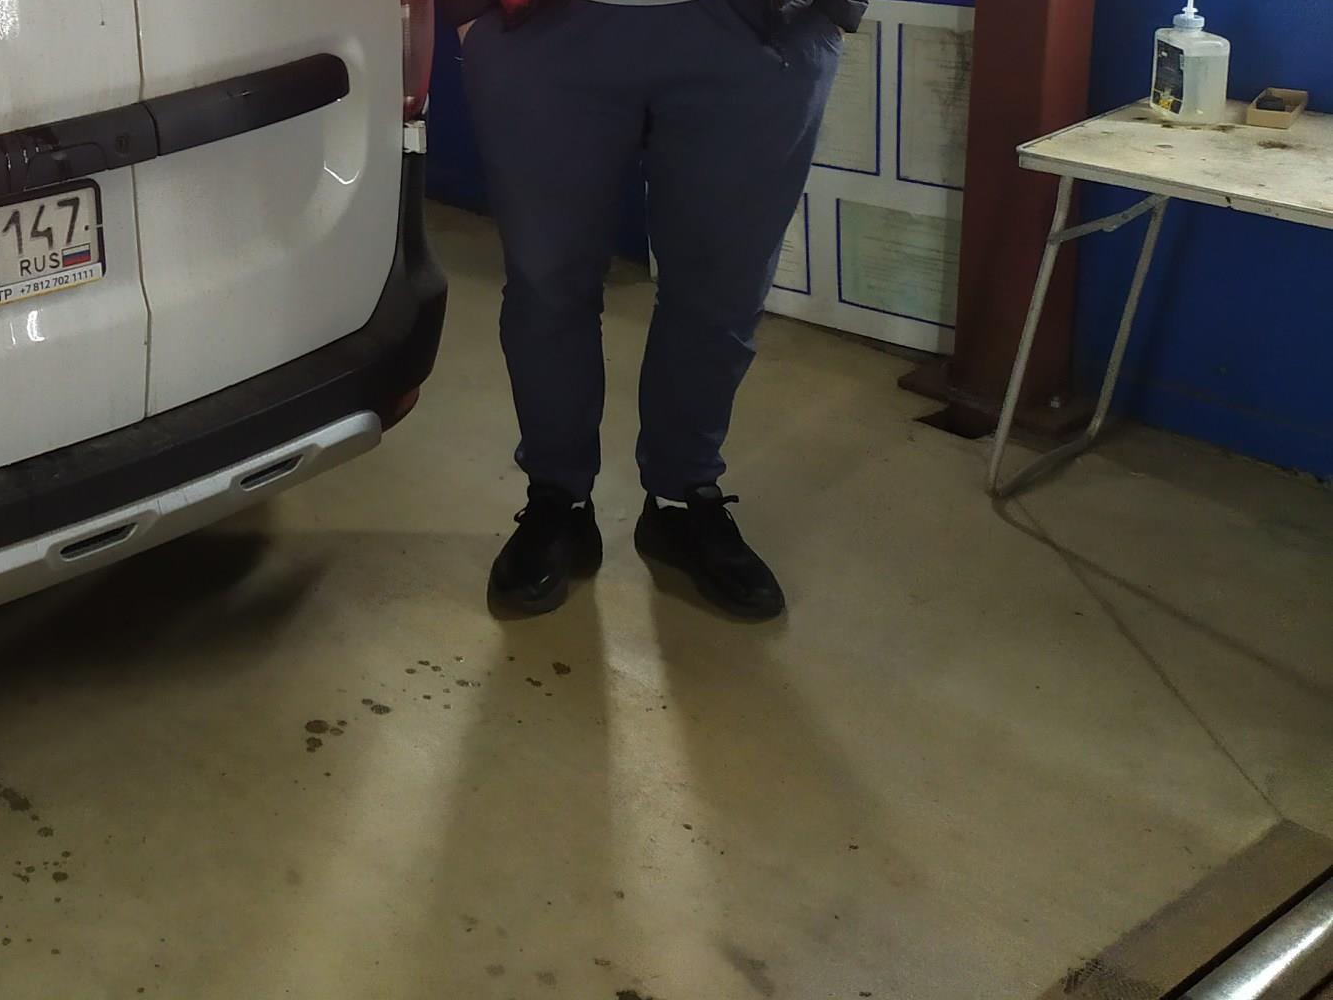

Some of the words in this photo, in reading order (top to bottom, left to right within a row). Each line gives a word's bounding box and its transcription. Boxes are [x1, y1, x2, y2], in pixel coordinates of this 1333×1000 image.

[2, 196, 81, 256] 147
[20, 253, 61, 277] RUS
[33, 280, 51, 292] 812
[53, 275, 70, 288] 702
